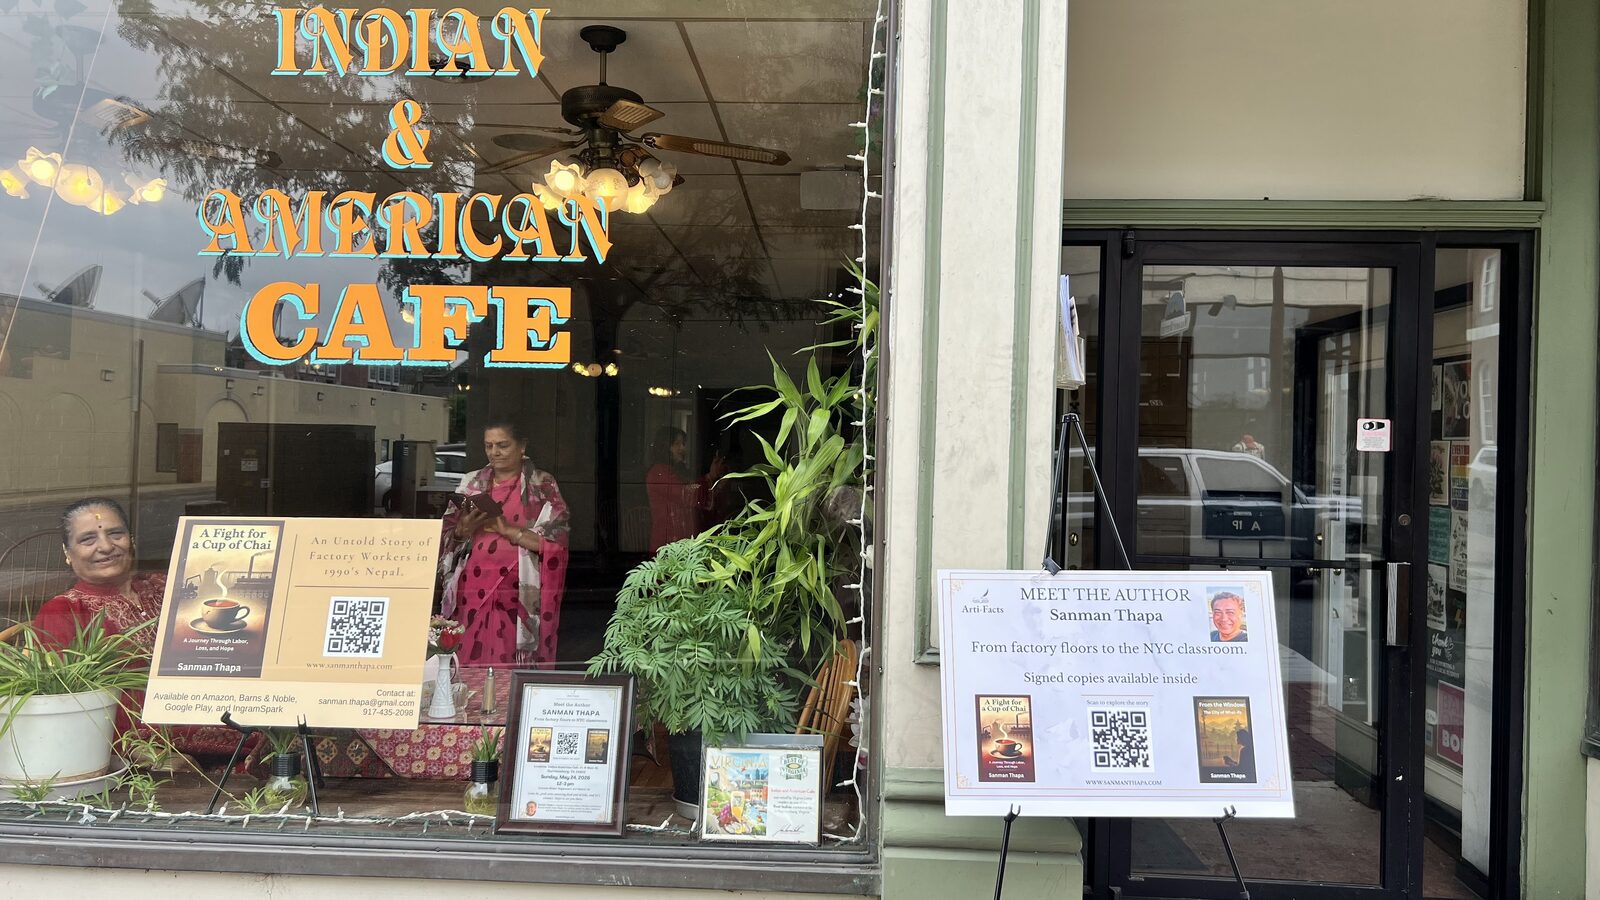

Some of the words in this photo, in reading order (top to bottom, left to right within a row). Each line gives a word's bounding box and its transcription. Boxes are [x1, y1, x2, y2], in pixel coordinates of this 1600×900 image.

[270, 7, 551, 78] INDIAN
[381, 98, 433, 169] &
[198, 188, 613, 264] AMERICAN
[240, 281, 571, 369] CAFE
[200, 528, 209, 538] A
[213, 528, 244, 540] Fight
[247, 528, 267, 538] for
[202, 540, 226, 552] Cup
[229, 540, 242, 549] of
[244, 540, 271, 550] Chai
[311, 536, 327, 545] An
[334, 536, 375, 546] Untold
[381, 537, 414, 549] Story
[418, 537, 432, 546] of
[309, 552, 354, 563] Factory
[361, 552, 411, 561] Workers
[416, 553, 428, 562] in
[324, 567, 360, 577] 1990's
[366, 567, 404, 579] Nepal.
[1020, 587, 1070, 600] MEET
[1072, 588, 1110, 601] THE
[1115, 588, 1191, 602] AUTHOR
[962, 605, 1004, 614] Arti-Facts
[1050, 608, 1111, 621] Sanman
[1114, 609, 1163, 624] Thapa
[972, 641, 1007, 653] From
[1011, 641, 1057, 656] factory
[1061, 642, 1098, 654] floors
[1102, 644, 1115, 654] to
[1118, 643, 1139, 654] the
[1143, 643, 1174, 654] NYC
[1178, 643, 1247, 654] classroom.
[178, 663, 212, 671] Sanman
[214, 663, 241, 673] Thapa
[306, 661, 393, 672] www.sanmanthapa.com
[1024, 672, 1064, 685] Signed
[1067, 673, 1104, 685] copies
[1108, 672, 1159, 684] available
[1162, 673, 1198, 684] inside
[154, 692, 188, 700] Available
[202, 693, 236, 702] Amazon,
[239, 694, 262, 702] Barns
[264, 694, 270, 702] &
[272, 695, 298, 704] Noble,
[376, 689, 405, 697] Contact
[165, 703, 193, 713] Google
[195, 703, 214, 713] Play,
[216, 704, 230, 712] and
[232, 704, 283, 714] IngramSpark
[318, 698, 415, 707] sanman.thapa@gmail.com
[1442, 729, 1464, 754] BO
[712, 755, 768, 768] VIRGINIA
